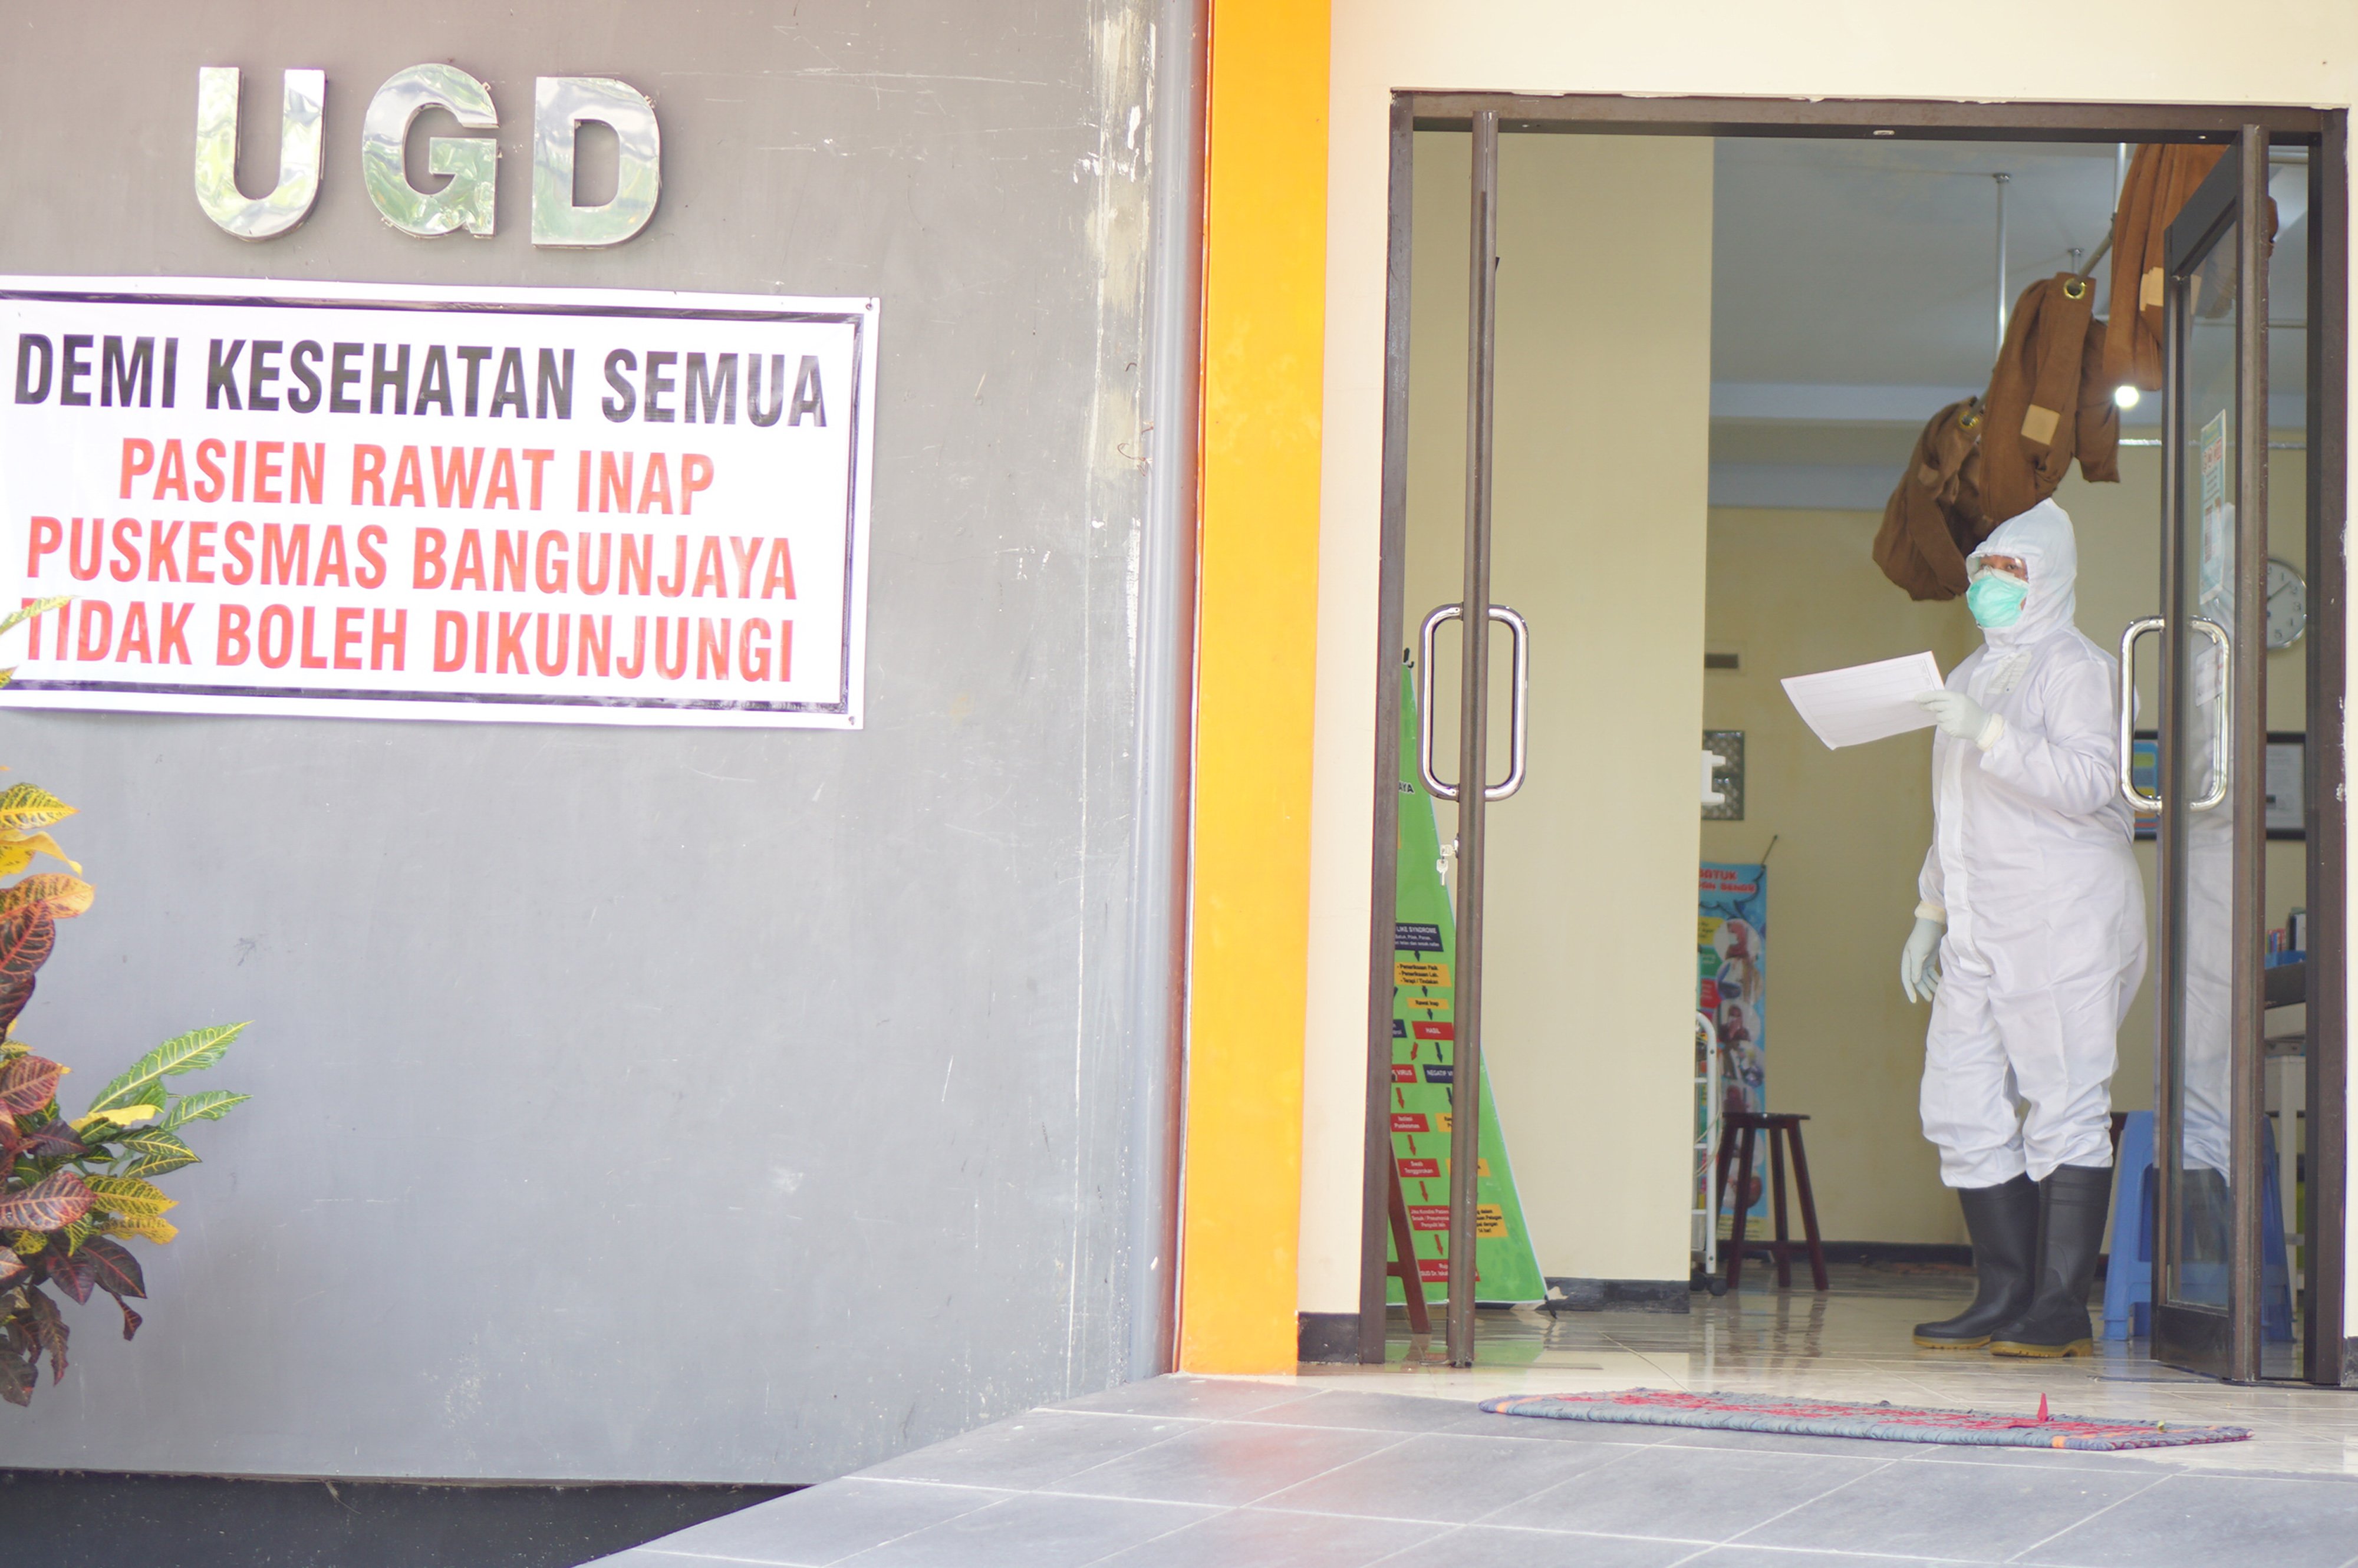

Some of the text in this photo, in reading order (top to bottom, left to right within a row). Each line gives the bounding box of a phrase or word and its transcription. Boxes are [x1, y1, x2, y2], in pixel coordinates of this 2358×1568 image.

[195, 62, 663, 250] UGD
[14, 333, 828, 428] DEMI KESEHATAN SEMUA
[119, 437, 714, 516] PASIEN RAWAT INAP
[27, 515, 797, 601] PUSKESMAS BANGUNJAYA
[21, 597, 793, 683] TIDAK BOLEH DIKUNJUNGI
